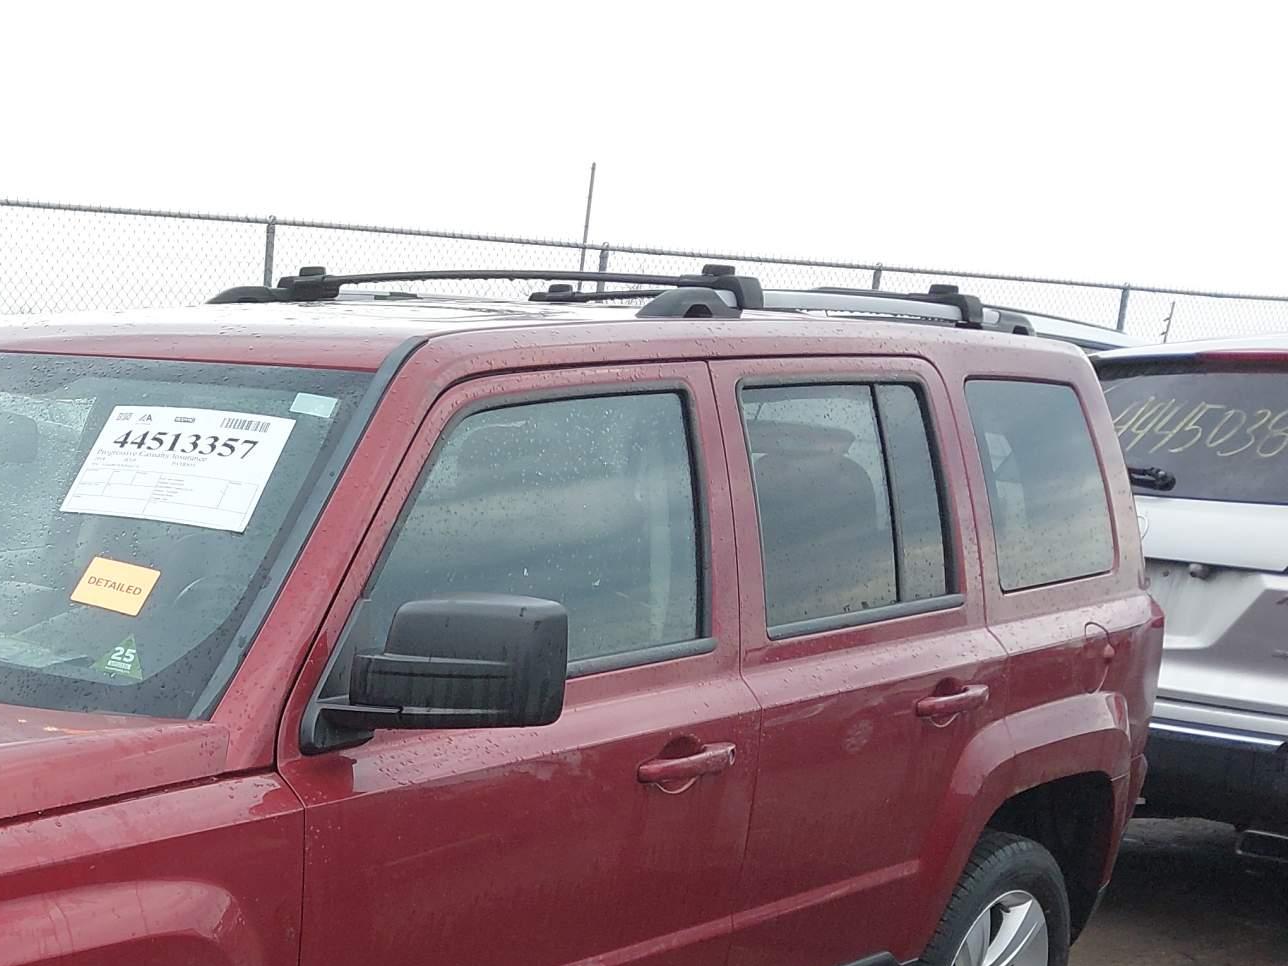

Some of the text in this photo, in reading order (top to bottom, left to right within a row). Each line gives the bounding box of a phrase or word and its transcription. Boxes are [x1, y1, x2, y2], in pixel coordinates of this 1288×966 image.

[113, 430, 259, 460] 44513357
[87, 575, 143, 596] DETAILED
[110, 646, 137, 662] 25
